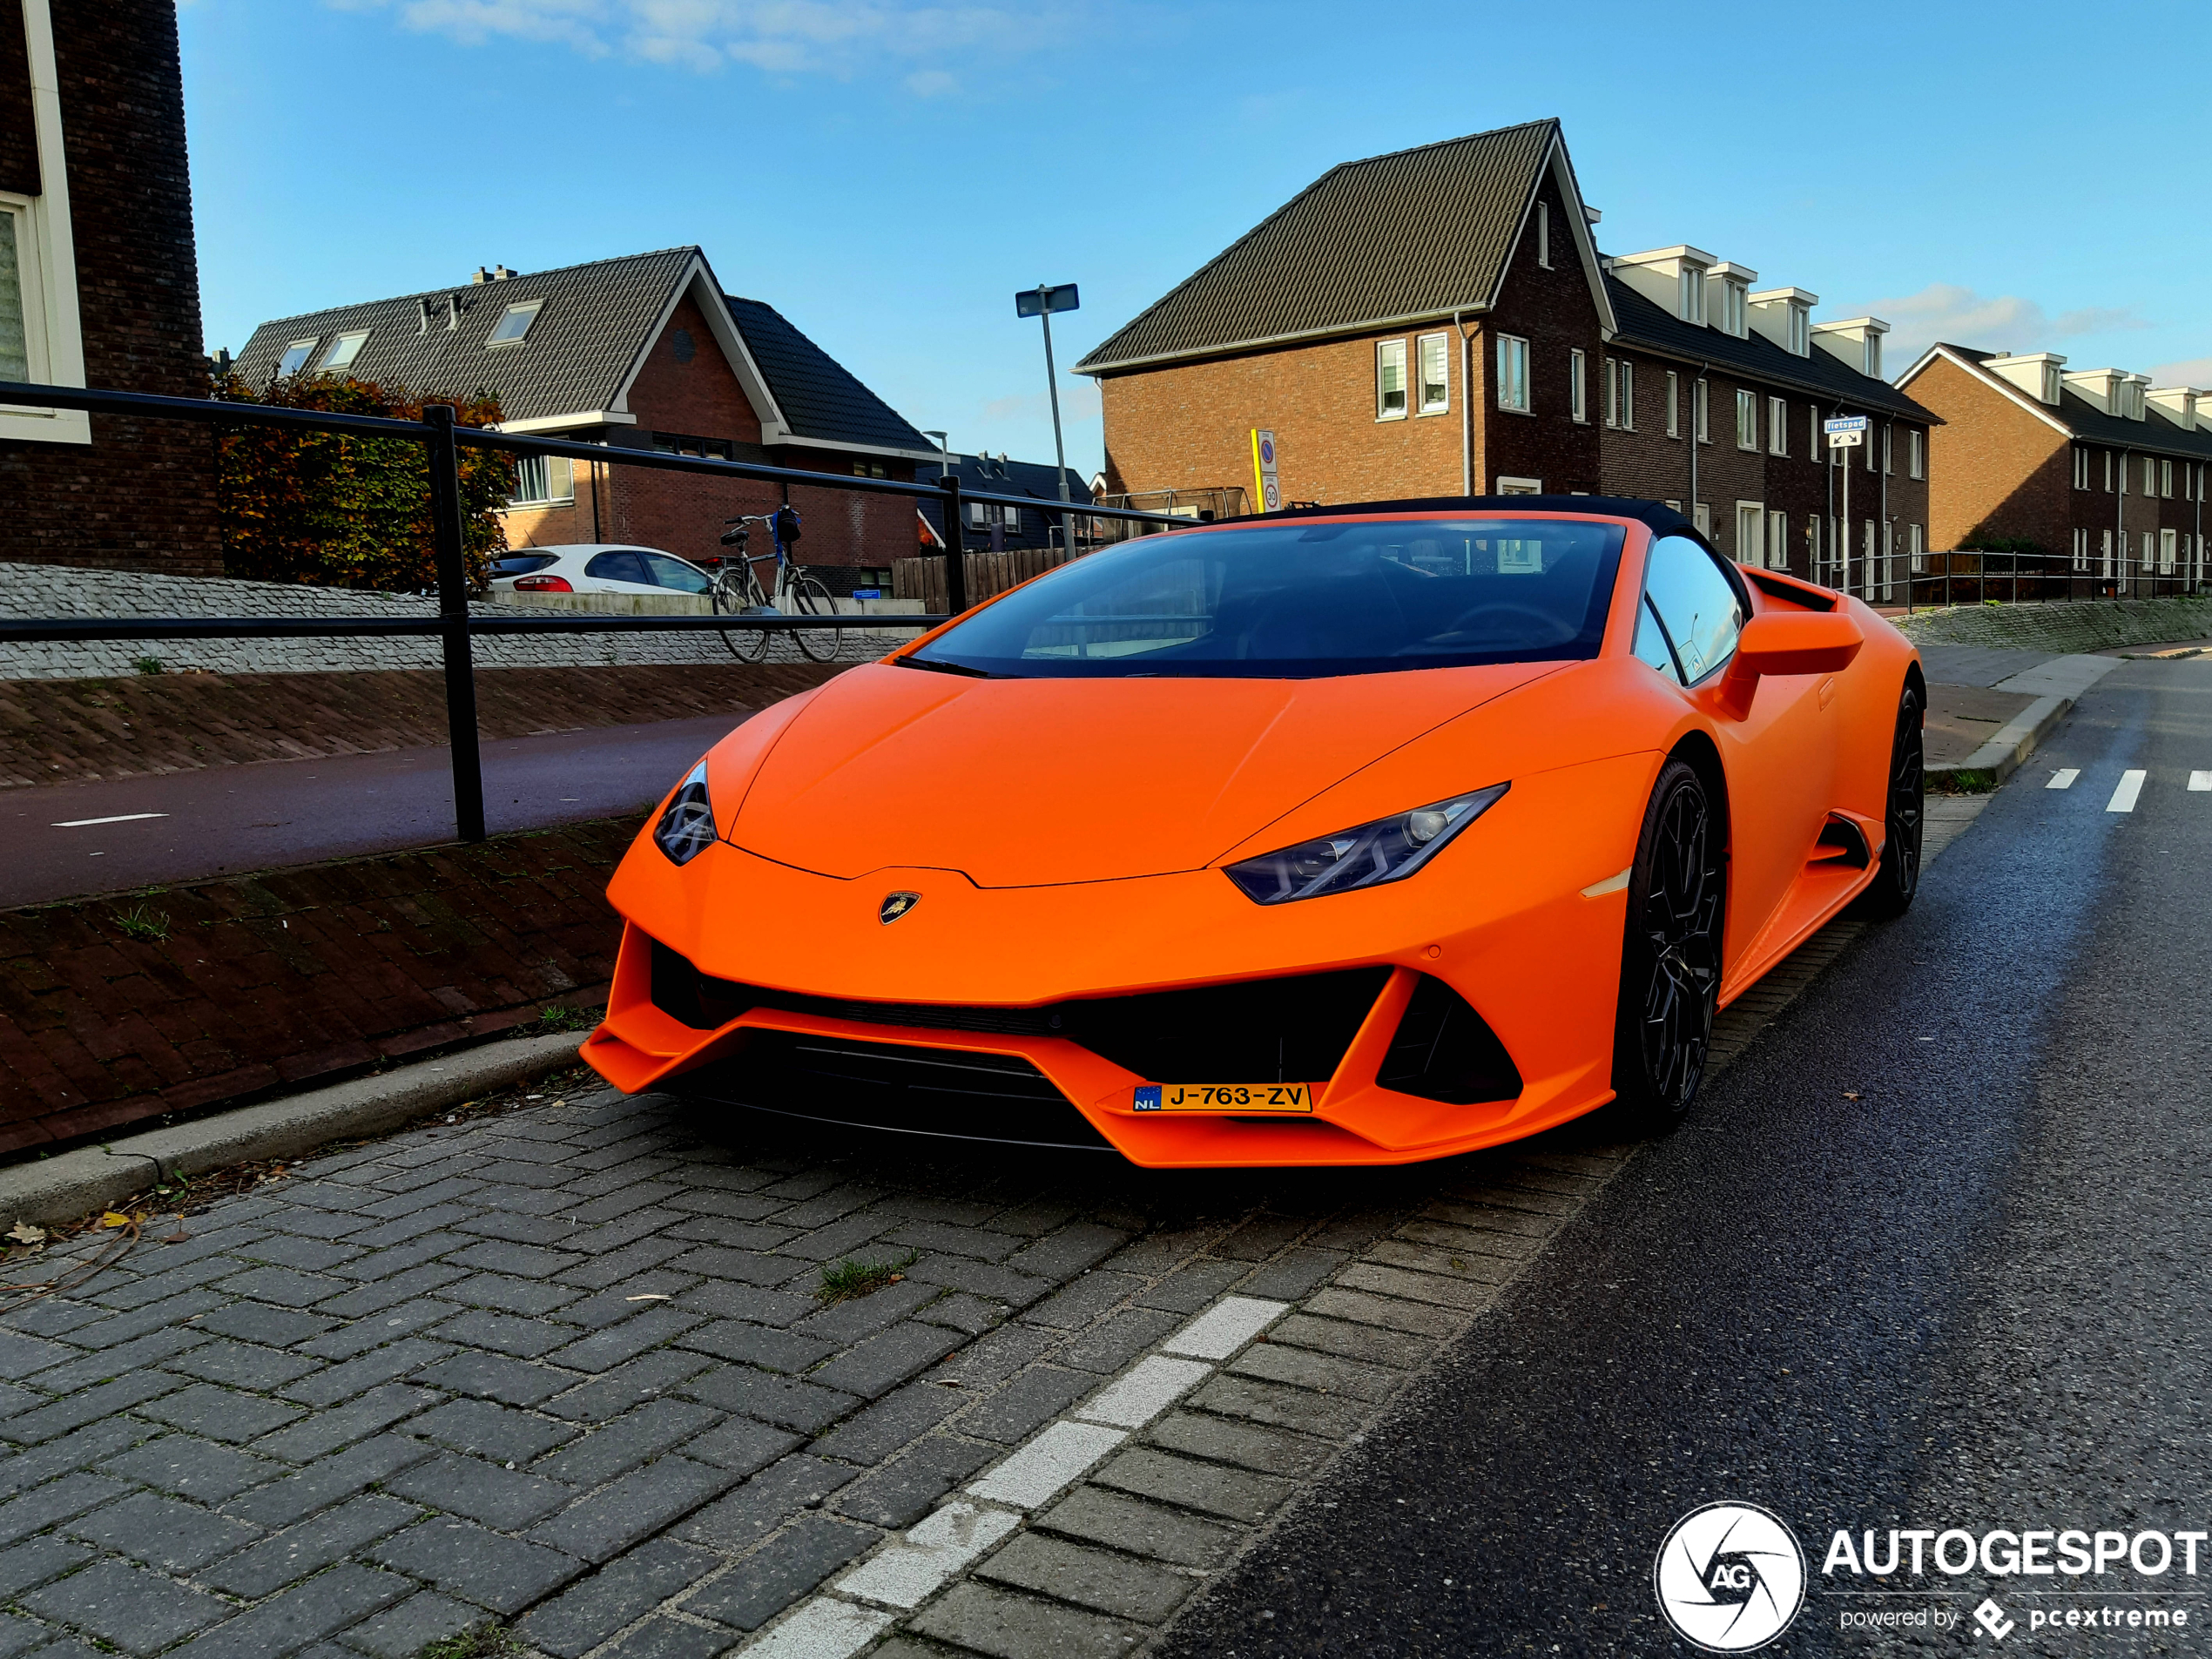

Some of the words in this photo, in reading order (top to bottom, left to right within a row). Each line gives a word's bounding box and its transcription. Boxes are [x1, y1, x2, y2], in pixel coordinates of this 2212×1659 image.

[1267, 491, 1276, 501] 30
[1170, 1087, 1303, 1105] J-763-ZV
[1135, 1100, 1160, 1109] NL
